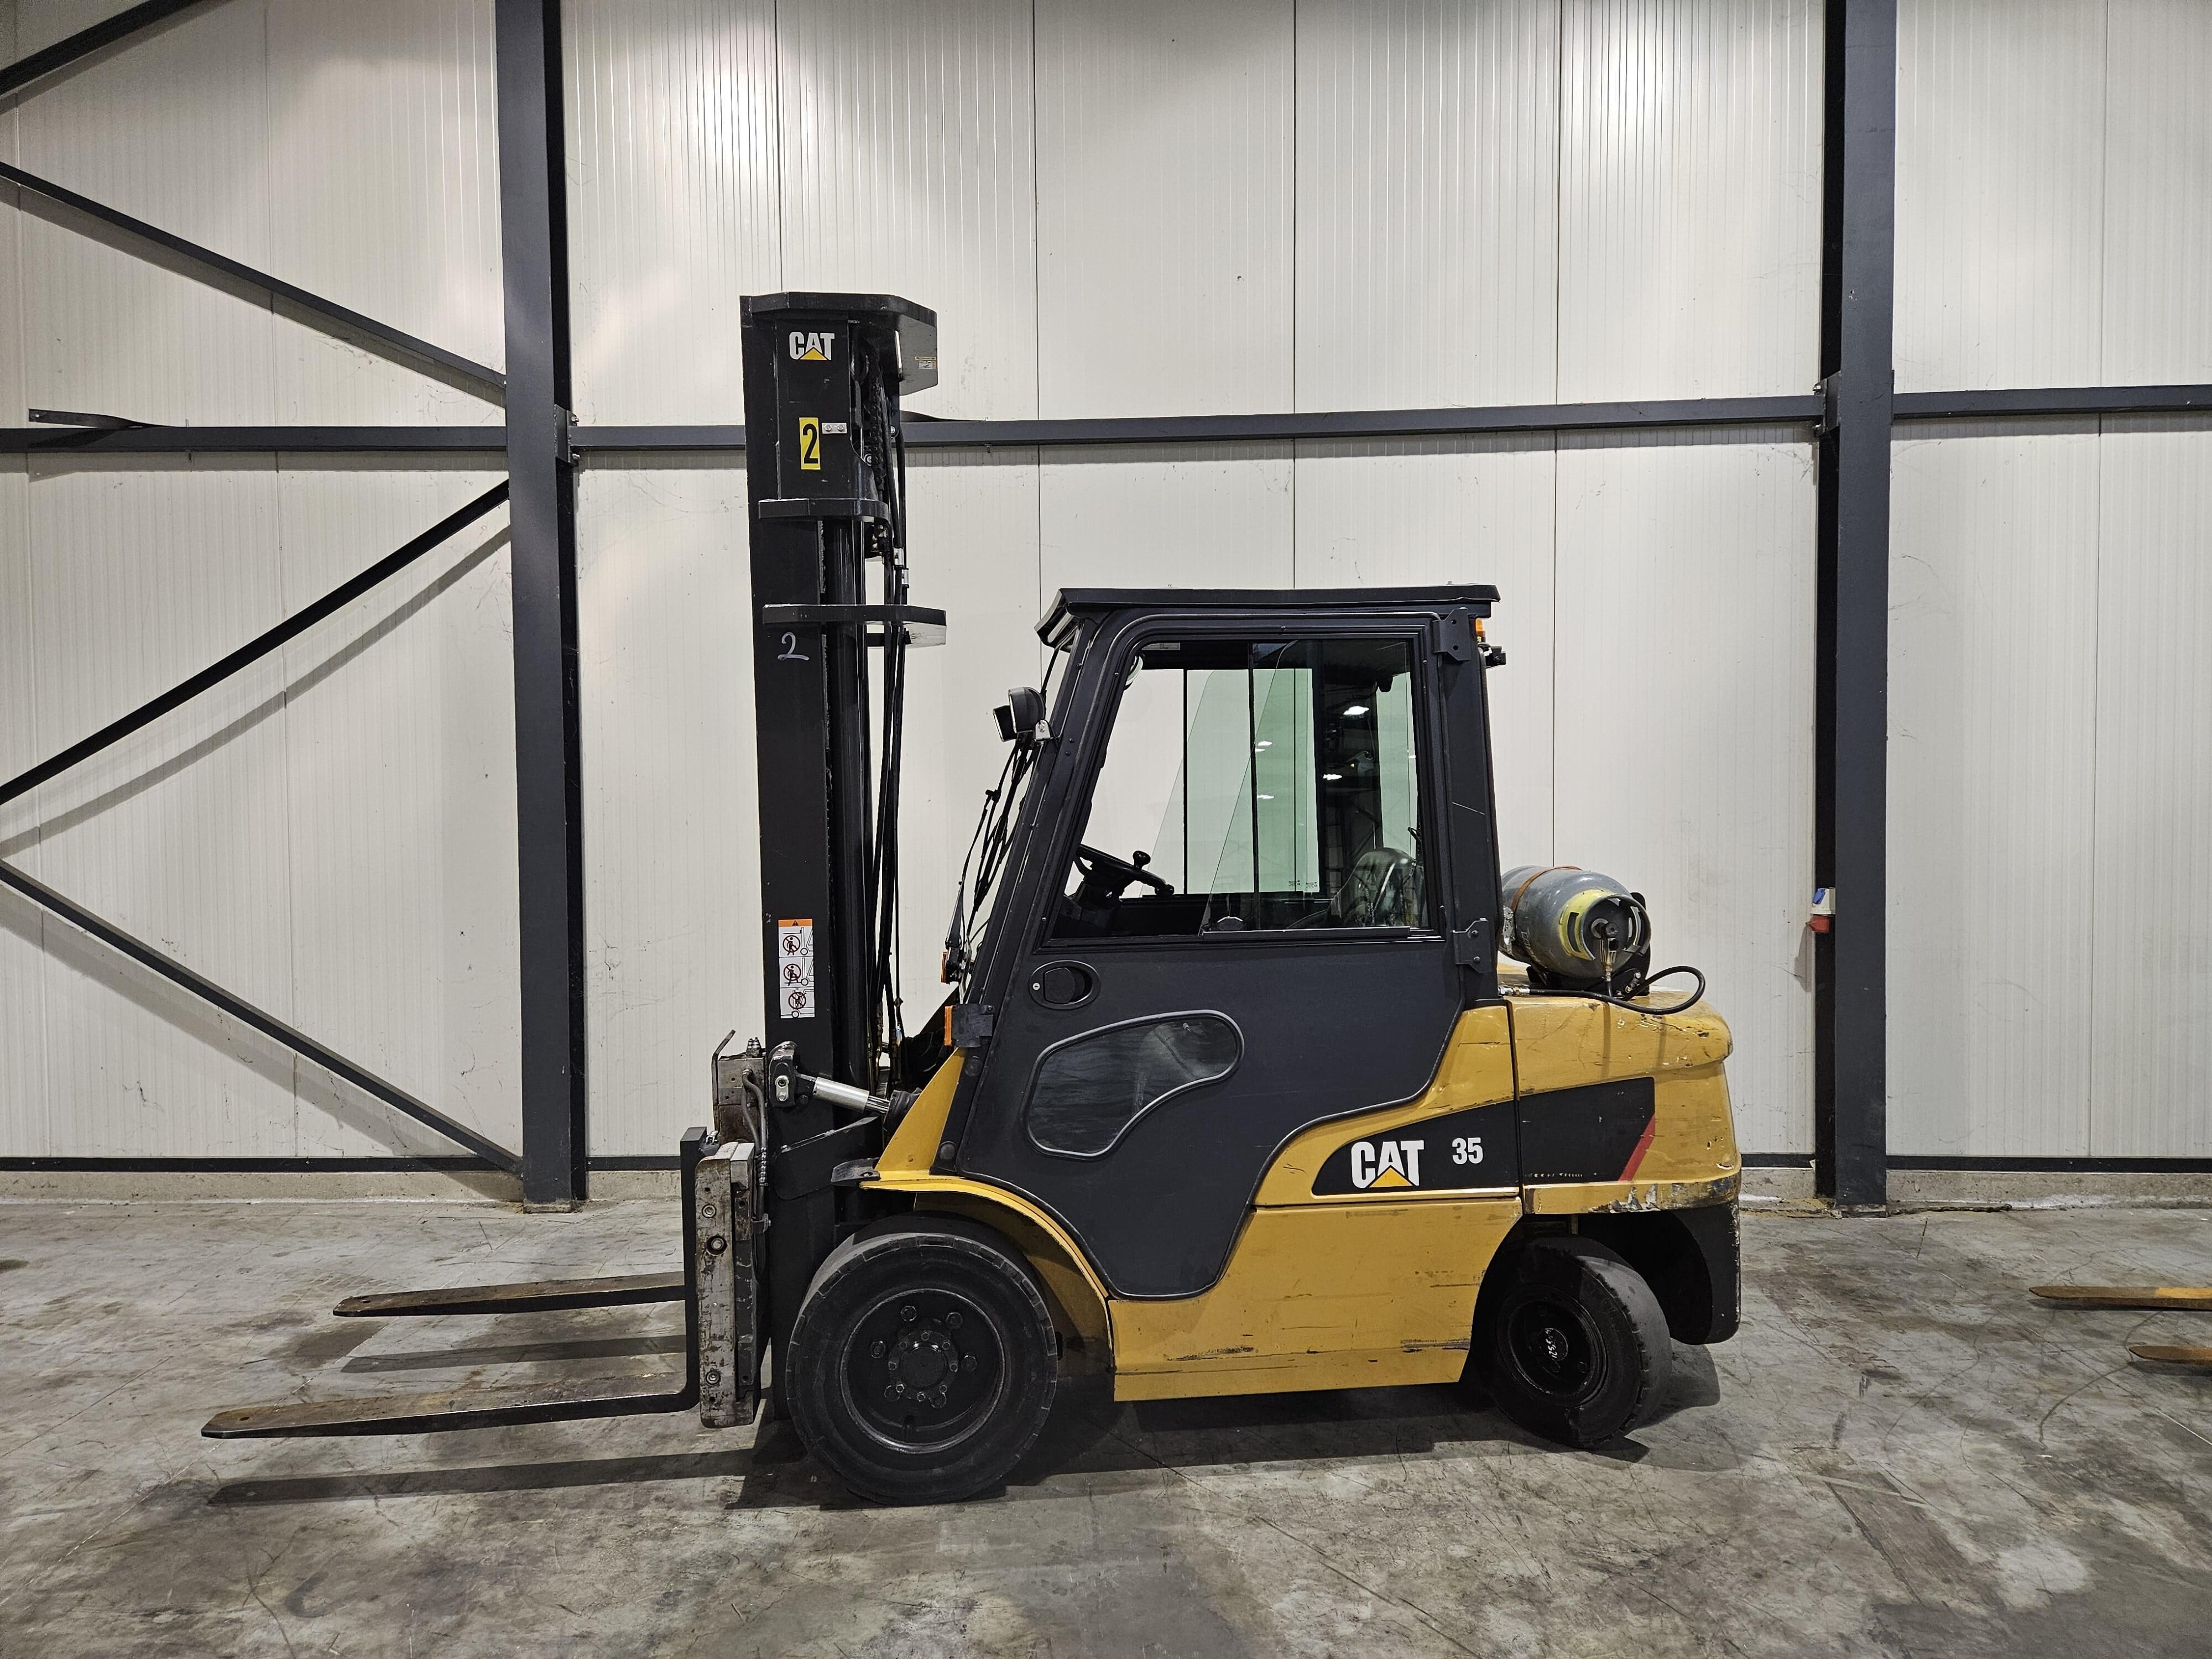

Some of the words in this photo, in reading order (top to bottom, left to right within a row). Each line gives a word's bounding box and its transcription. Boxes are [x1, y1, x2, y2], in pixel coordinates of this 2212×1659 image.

[789, 332, 835, 360] CAT
[803, 424, 818, 464] 2
[778, 632, 810, 661] 2
[1351, 1140, 1425, 1188] CAT
[1452, 1137, 1483, 1165] 35
